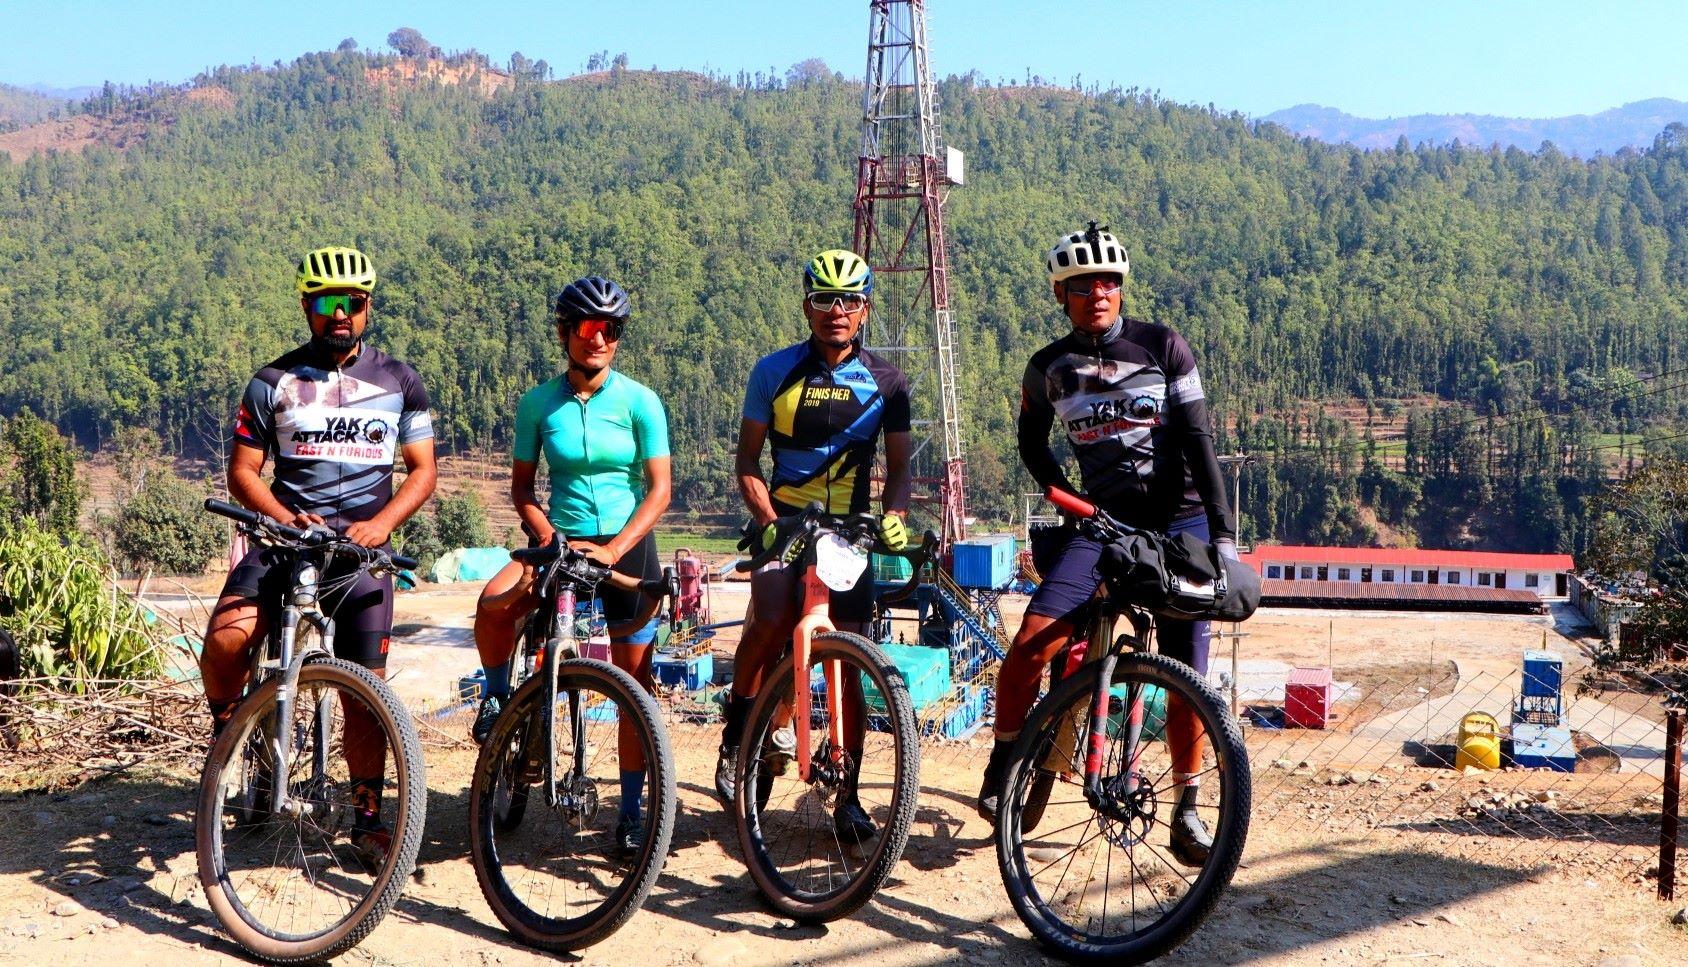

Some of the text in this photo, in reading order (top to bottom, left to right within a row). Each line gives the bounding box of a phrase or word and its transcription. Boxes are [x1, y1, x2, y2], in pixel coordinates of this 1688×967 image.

[803, 399, 820, 407] 2019
[1090, 399, 1127, 417] YAK
[325, 417, 363, 431] YAK
[291, 430, 359, 443] ATTACK
[296, 444, 384, 459] FAST N FURIOUS
